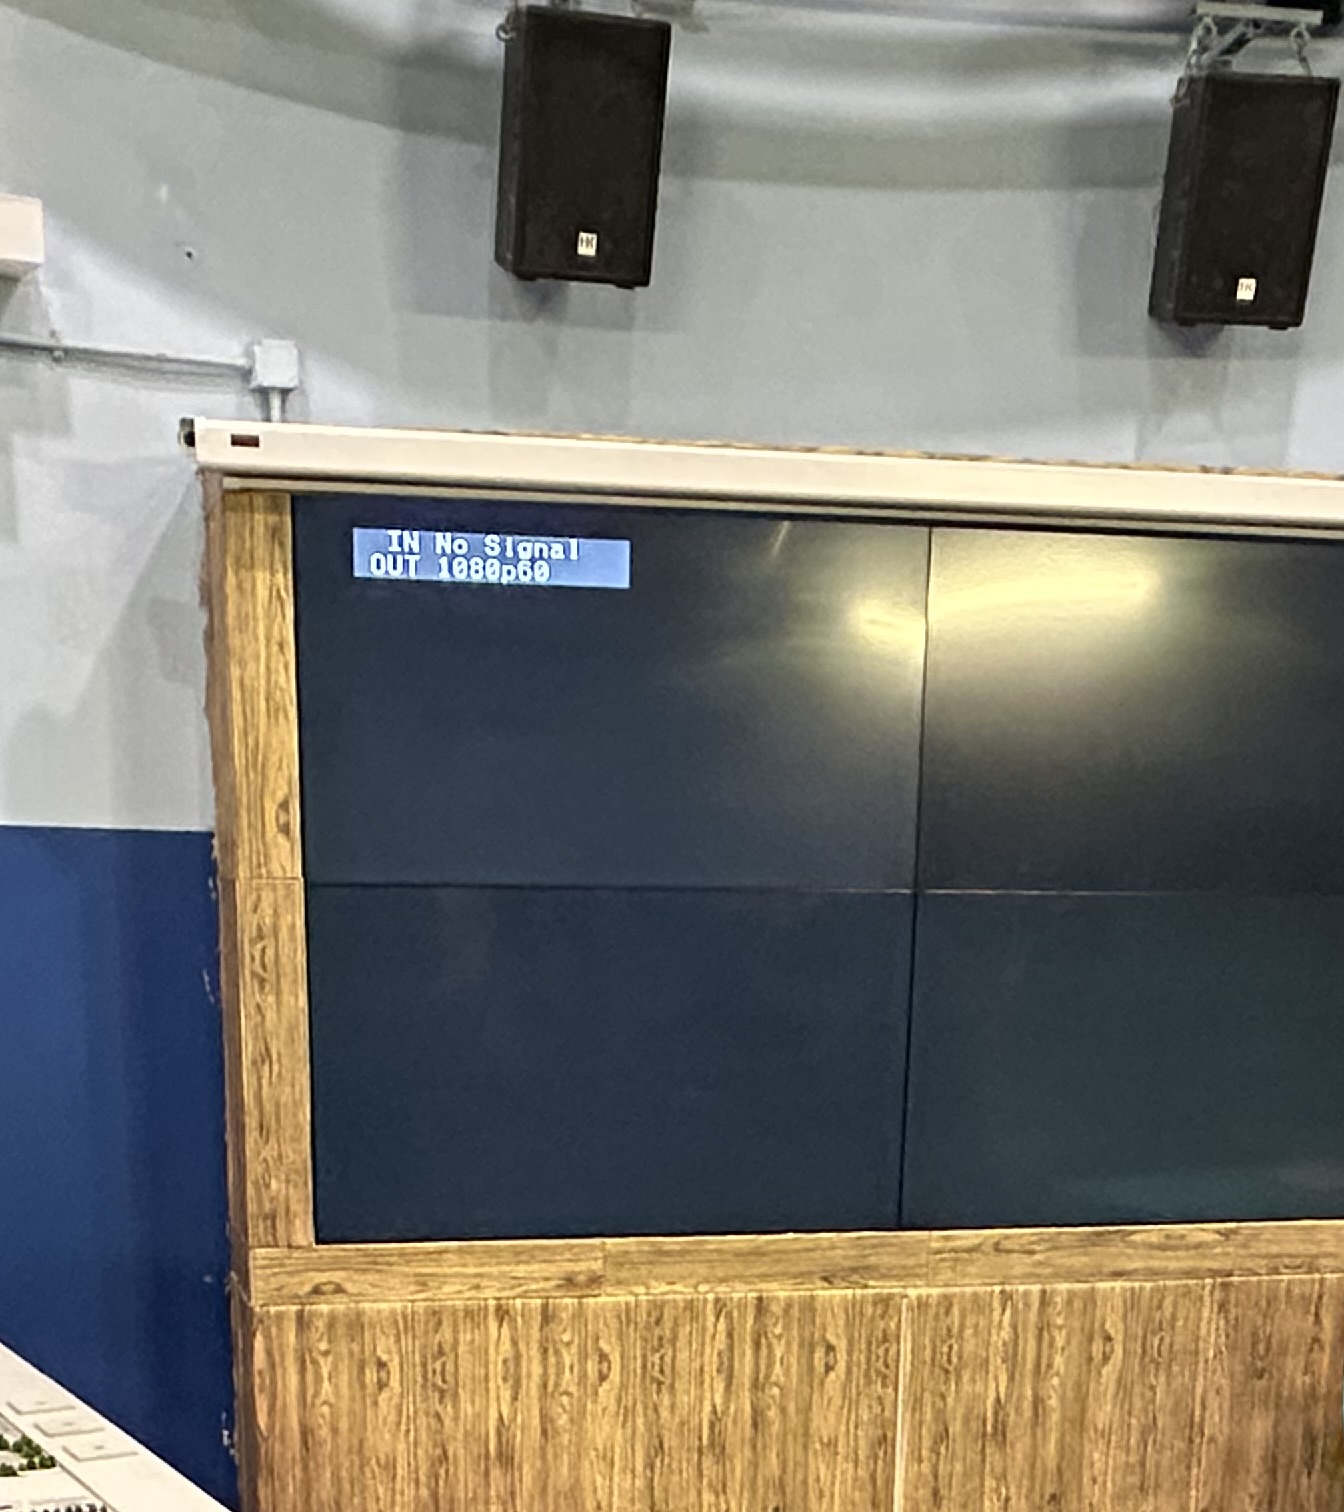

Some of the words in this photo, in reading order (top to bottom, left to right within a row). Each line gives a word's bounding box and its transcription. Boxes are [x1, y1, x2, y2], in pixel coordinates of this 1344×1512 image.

[387, 530, 420, 553] IN
[434, 532, 469, 555] No
[483, 534, 578, 560] Signal
[369, 553, 421, 577] OUT
[438, 556, 550, 584] 1080p60
